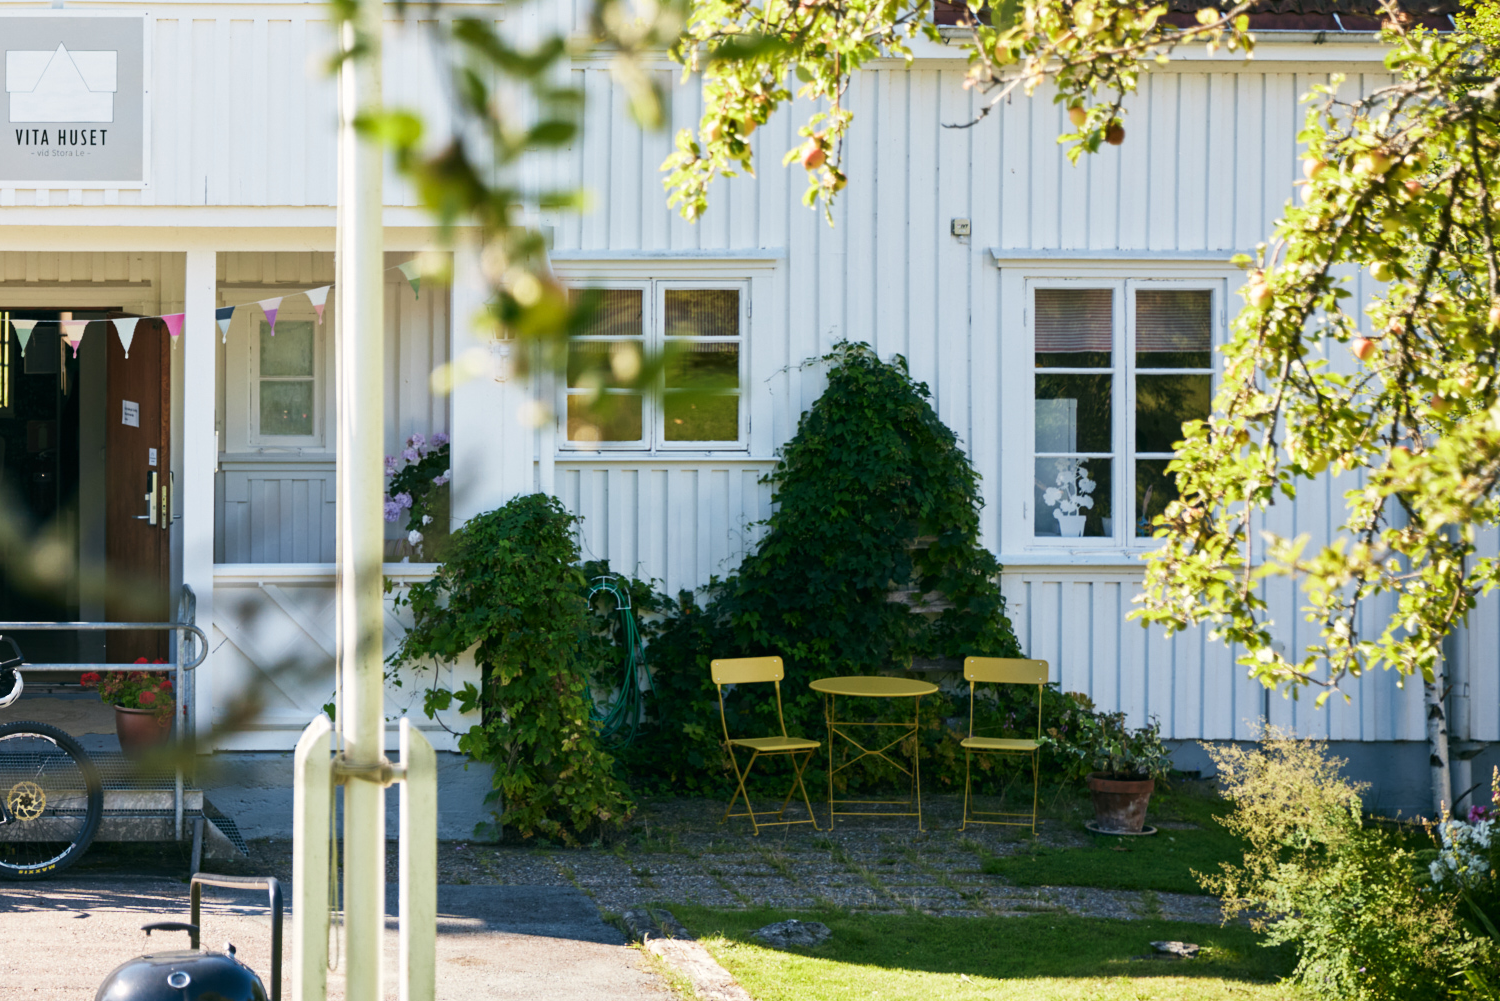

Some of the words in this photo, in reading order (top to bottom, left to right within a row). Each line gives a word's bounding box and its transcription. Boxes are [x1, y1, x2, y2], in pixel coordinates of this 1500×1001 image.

[16, 129, 49, 145] VITA
[58, 129, 107, 145] HUSET
[37, 149, 49, 157] vid
[52, 149, 73, 157] Stora
[75, 149, 85, 157] Le
[18, 864, 56, 874] MAXXIS
